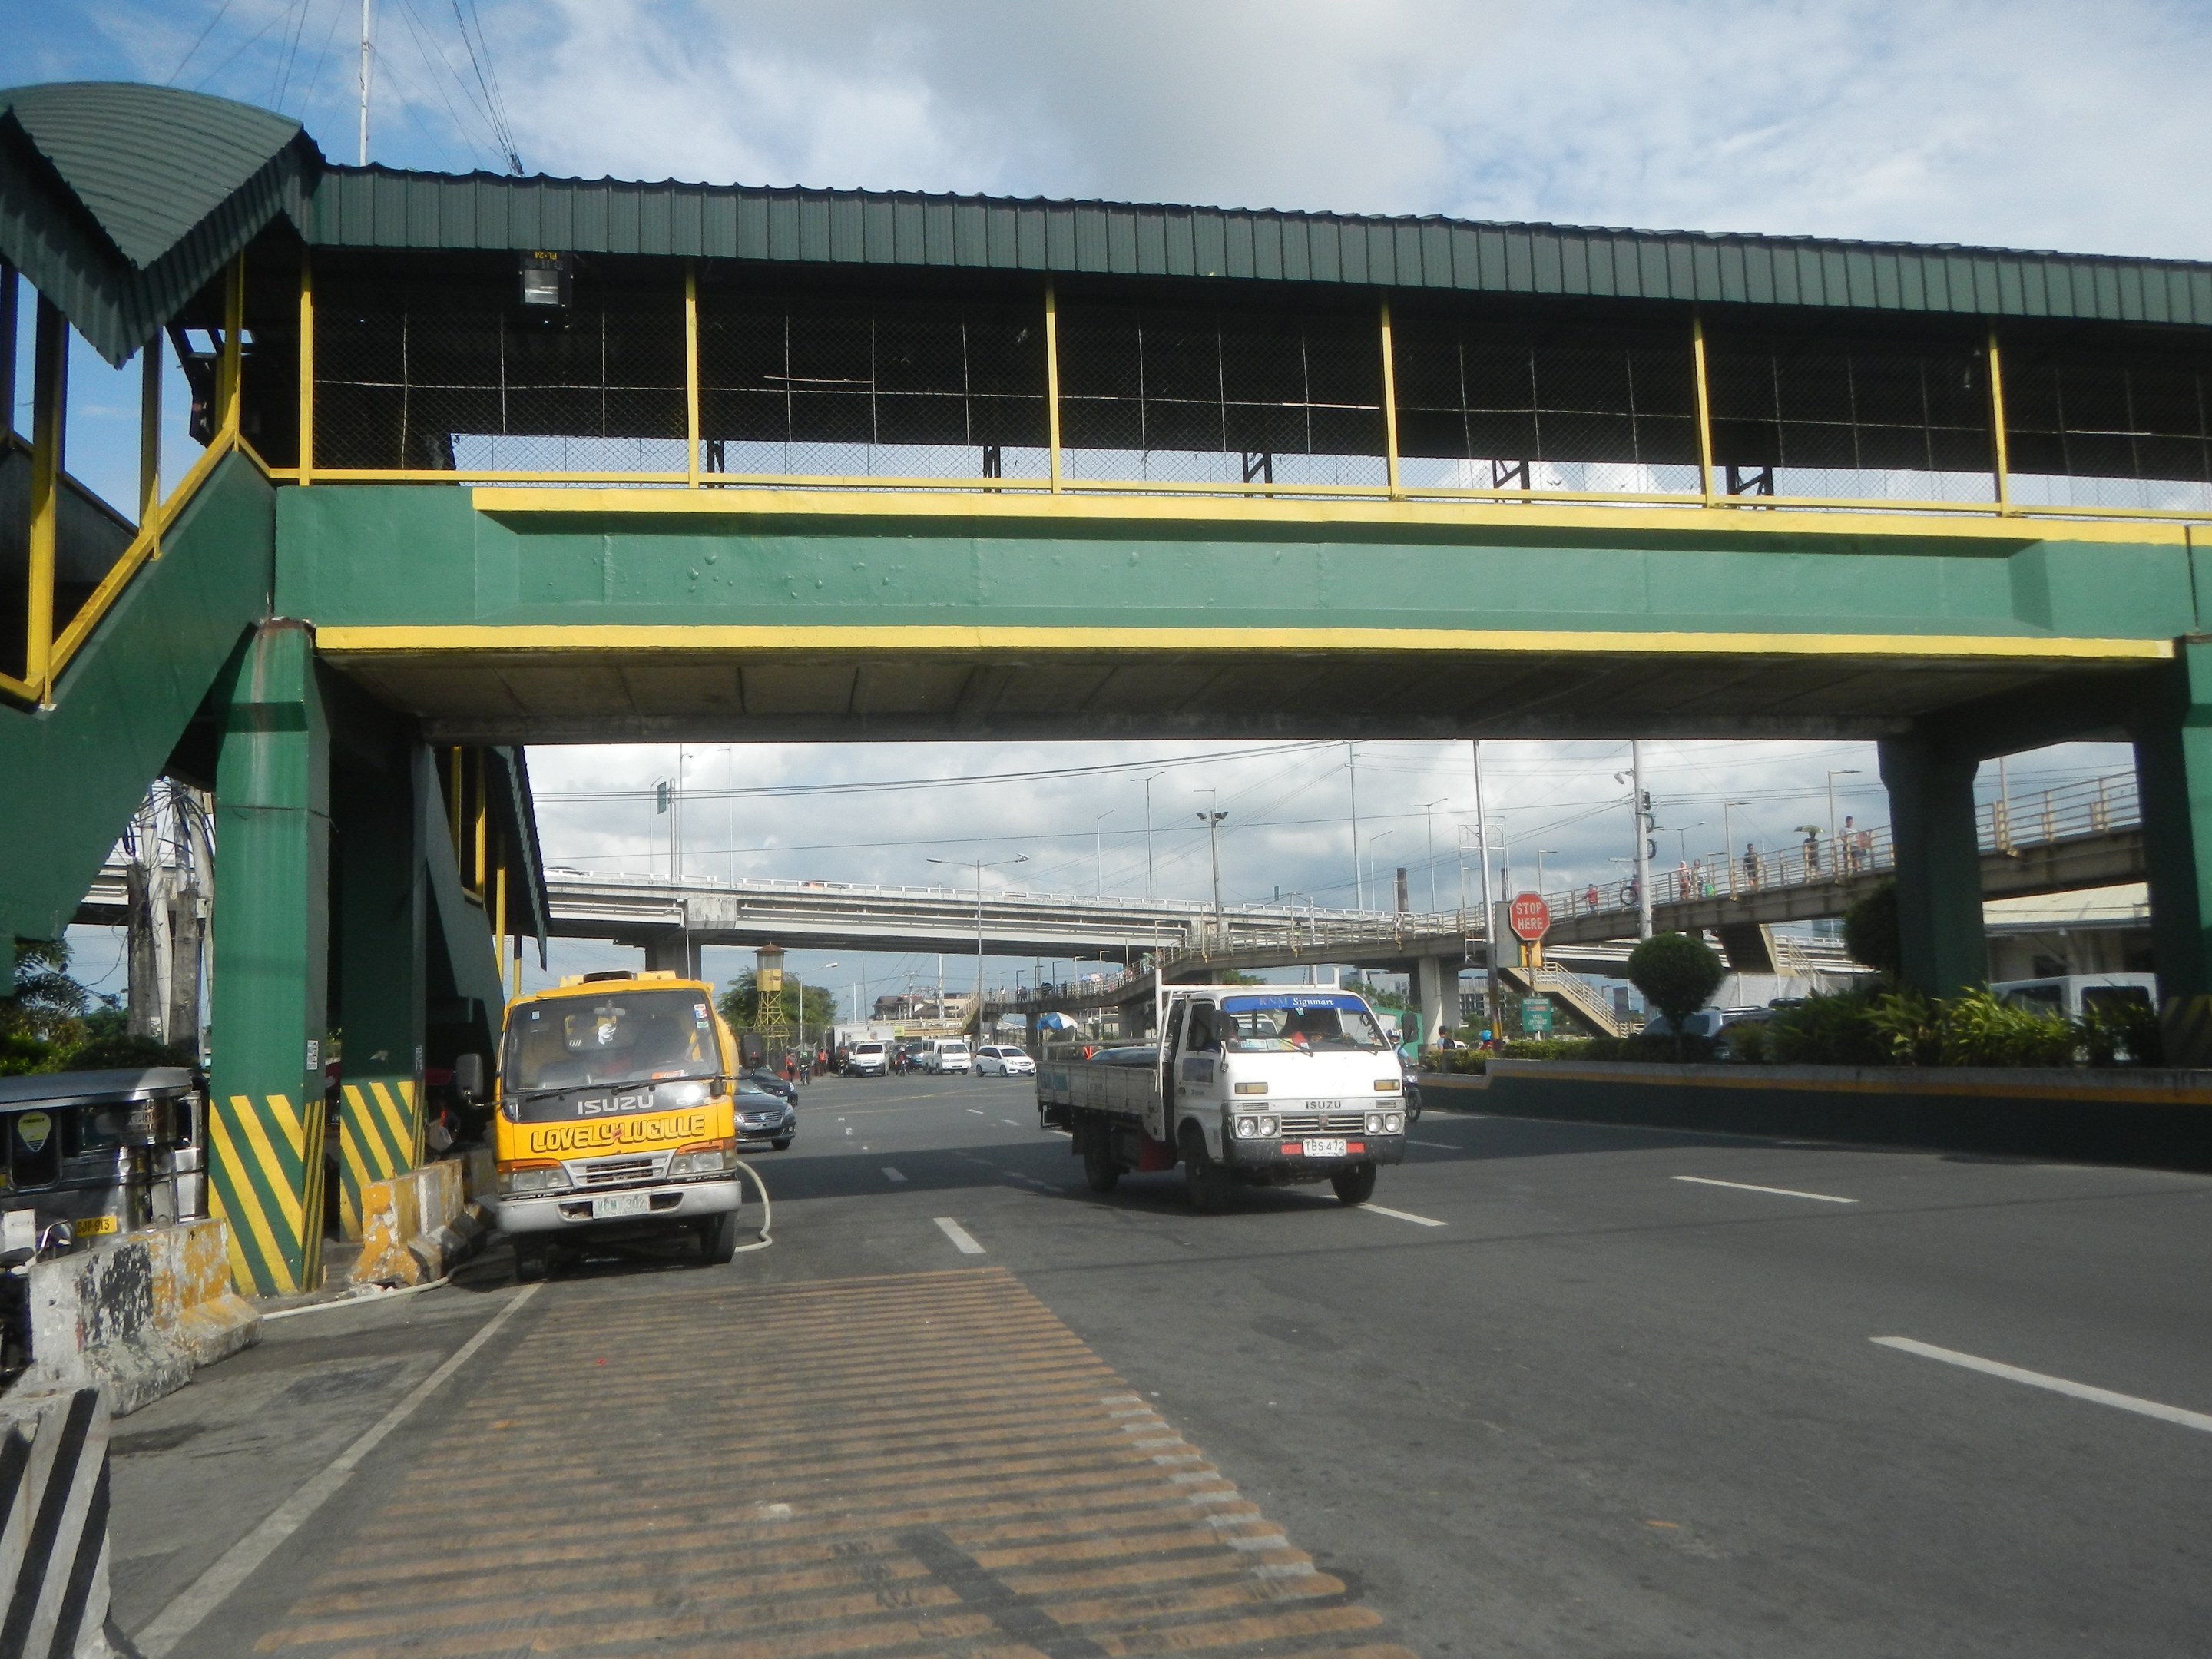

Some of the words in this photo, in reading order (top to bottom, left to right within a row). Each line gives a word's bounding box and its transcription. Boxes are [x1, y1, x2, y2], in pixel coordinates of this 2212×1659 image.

[1516, 902, 1542, 915] STOP
[1518, 917, 1543, 930] HERE
[1293, 998, 1333, 1007] Signmart
[578, 1094, 654, 1115] ISUZU
[1306, 1101, 1341, 1109] ISUZU
[531, 1122, 617, 1152] LOVELY
[616, 1114, 705, 1144] LUCILLE
[1305, 1141, 1324, 1151] TBS
[1326, 1141, 1345, 1151] 472
